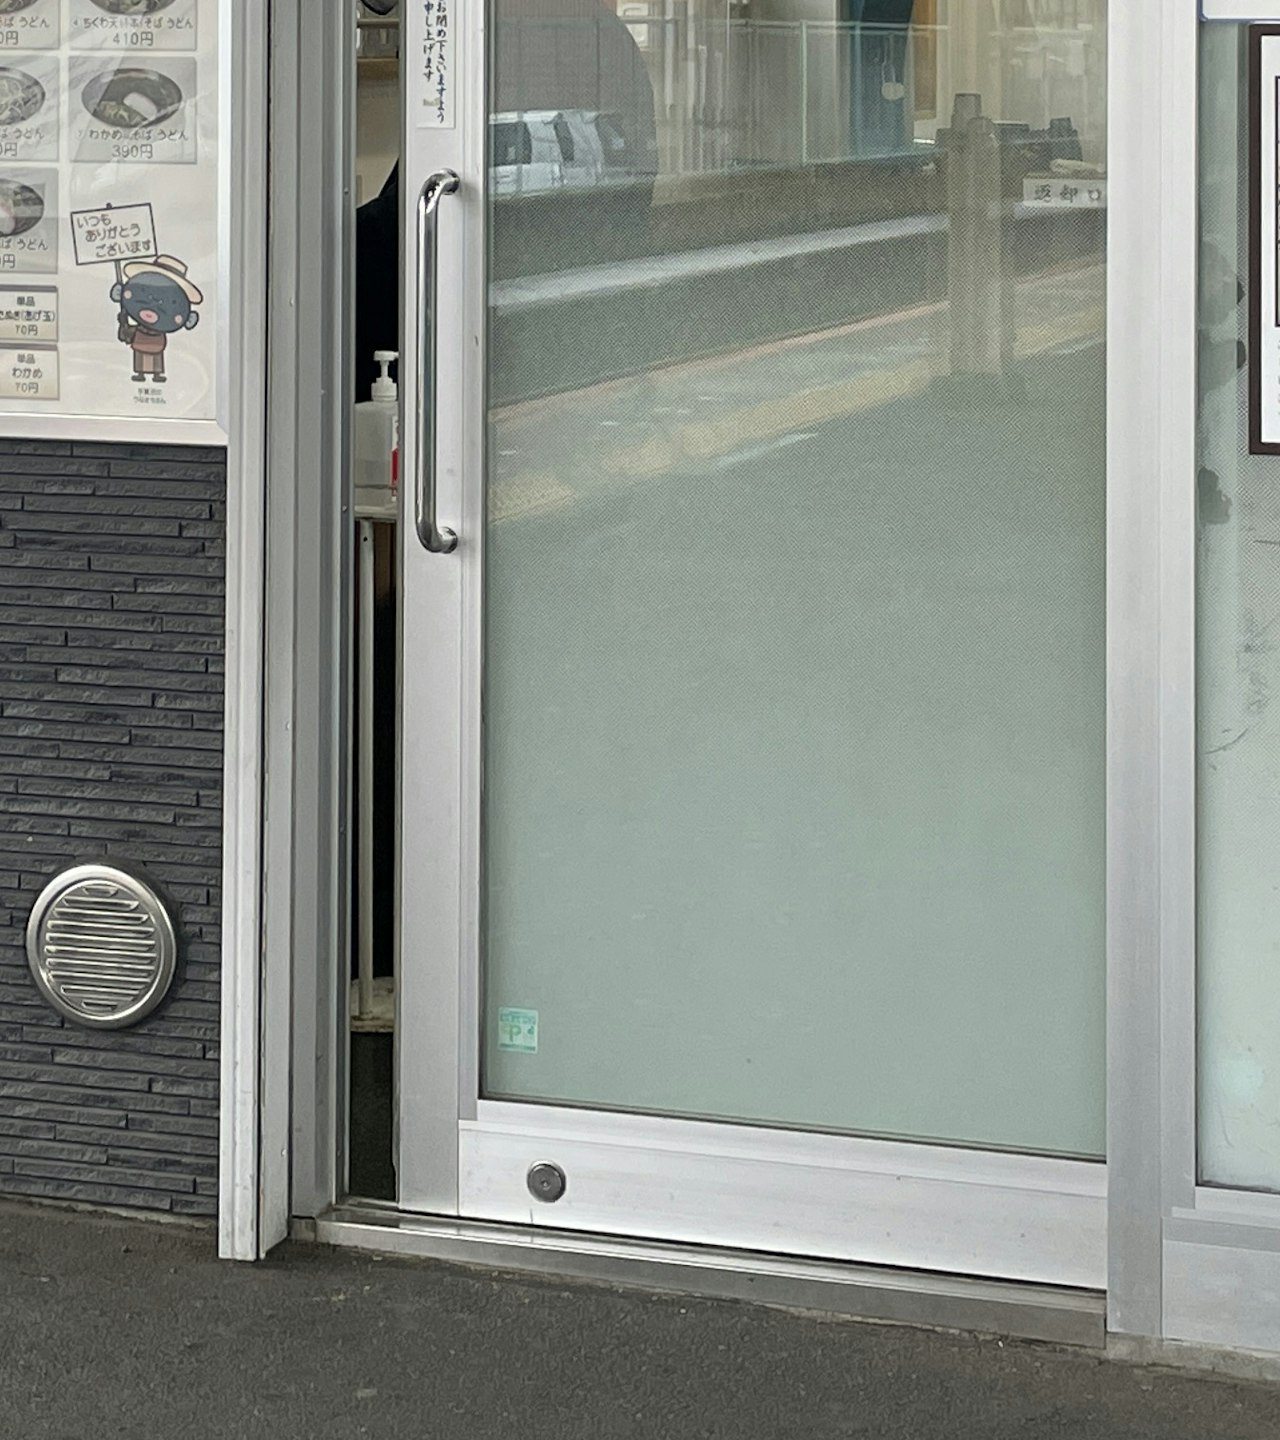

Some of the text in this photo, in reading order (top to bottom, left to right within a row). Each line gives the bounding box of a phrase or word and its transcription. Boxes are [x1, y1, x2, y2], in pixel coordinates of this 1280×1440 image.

[19, 15, 50, 28] うどん
[166, 16, 193, 29] うどん
[112, 31, 154, 46] 410円
[157, 129, 189, 142] うどん
[111, 143, 154, 160] 390円
[76, 213, 112, 229] いつも
[85, 223, 142, 243] ありがとう
[95, 239, 152, 259] ございます
